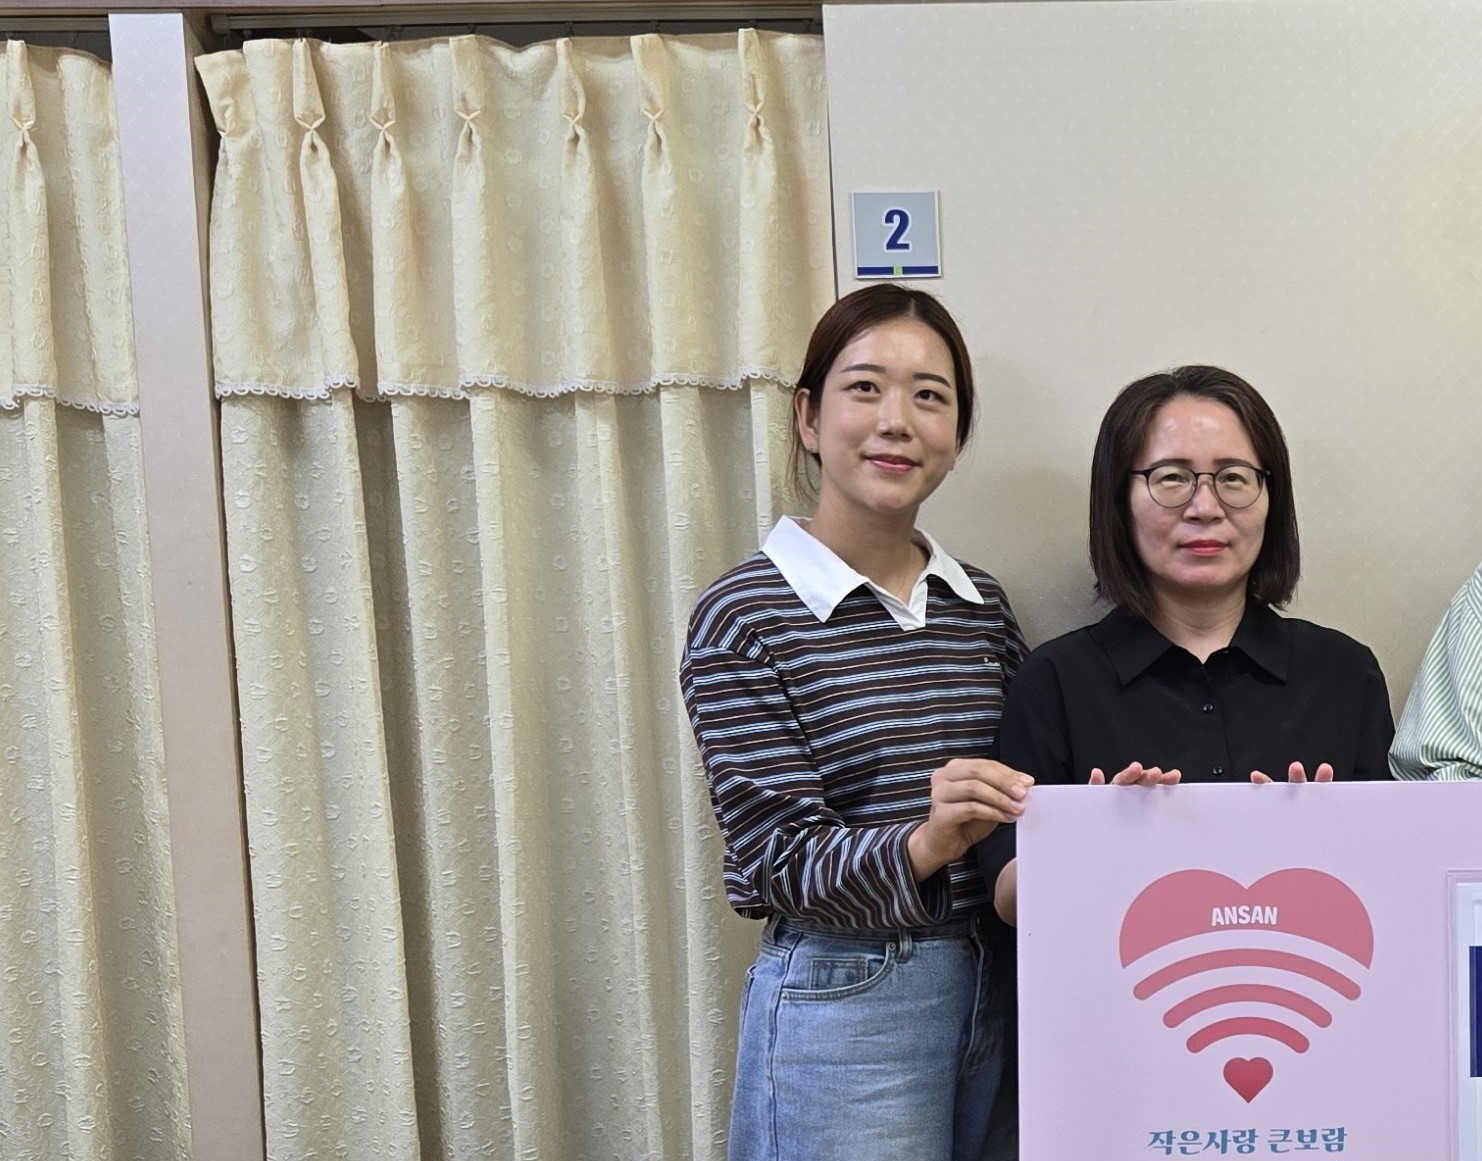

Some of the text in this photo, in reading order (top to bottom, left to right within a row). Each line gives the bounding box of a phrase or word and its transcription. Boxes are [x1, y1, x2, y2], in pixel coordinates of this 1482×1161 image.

[884, 208, 910, 251] 2
[1211, 905, 1278, 926] ANSAN
[1148, 1126, 1348, 1156] 작은사랑 큰보람
